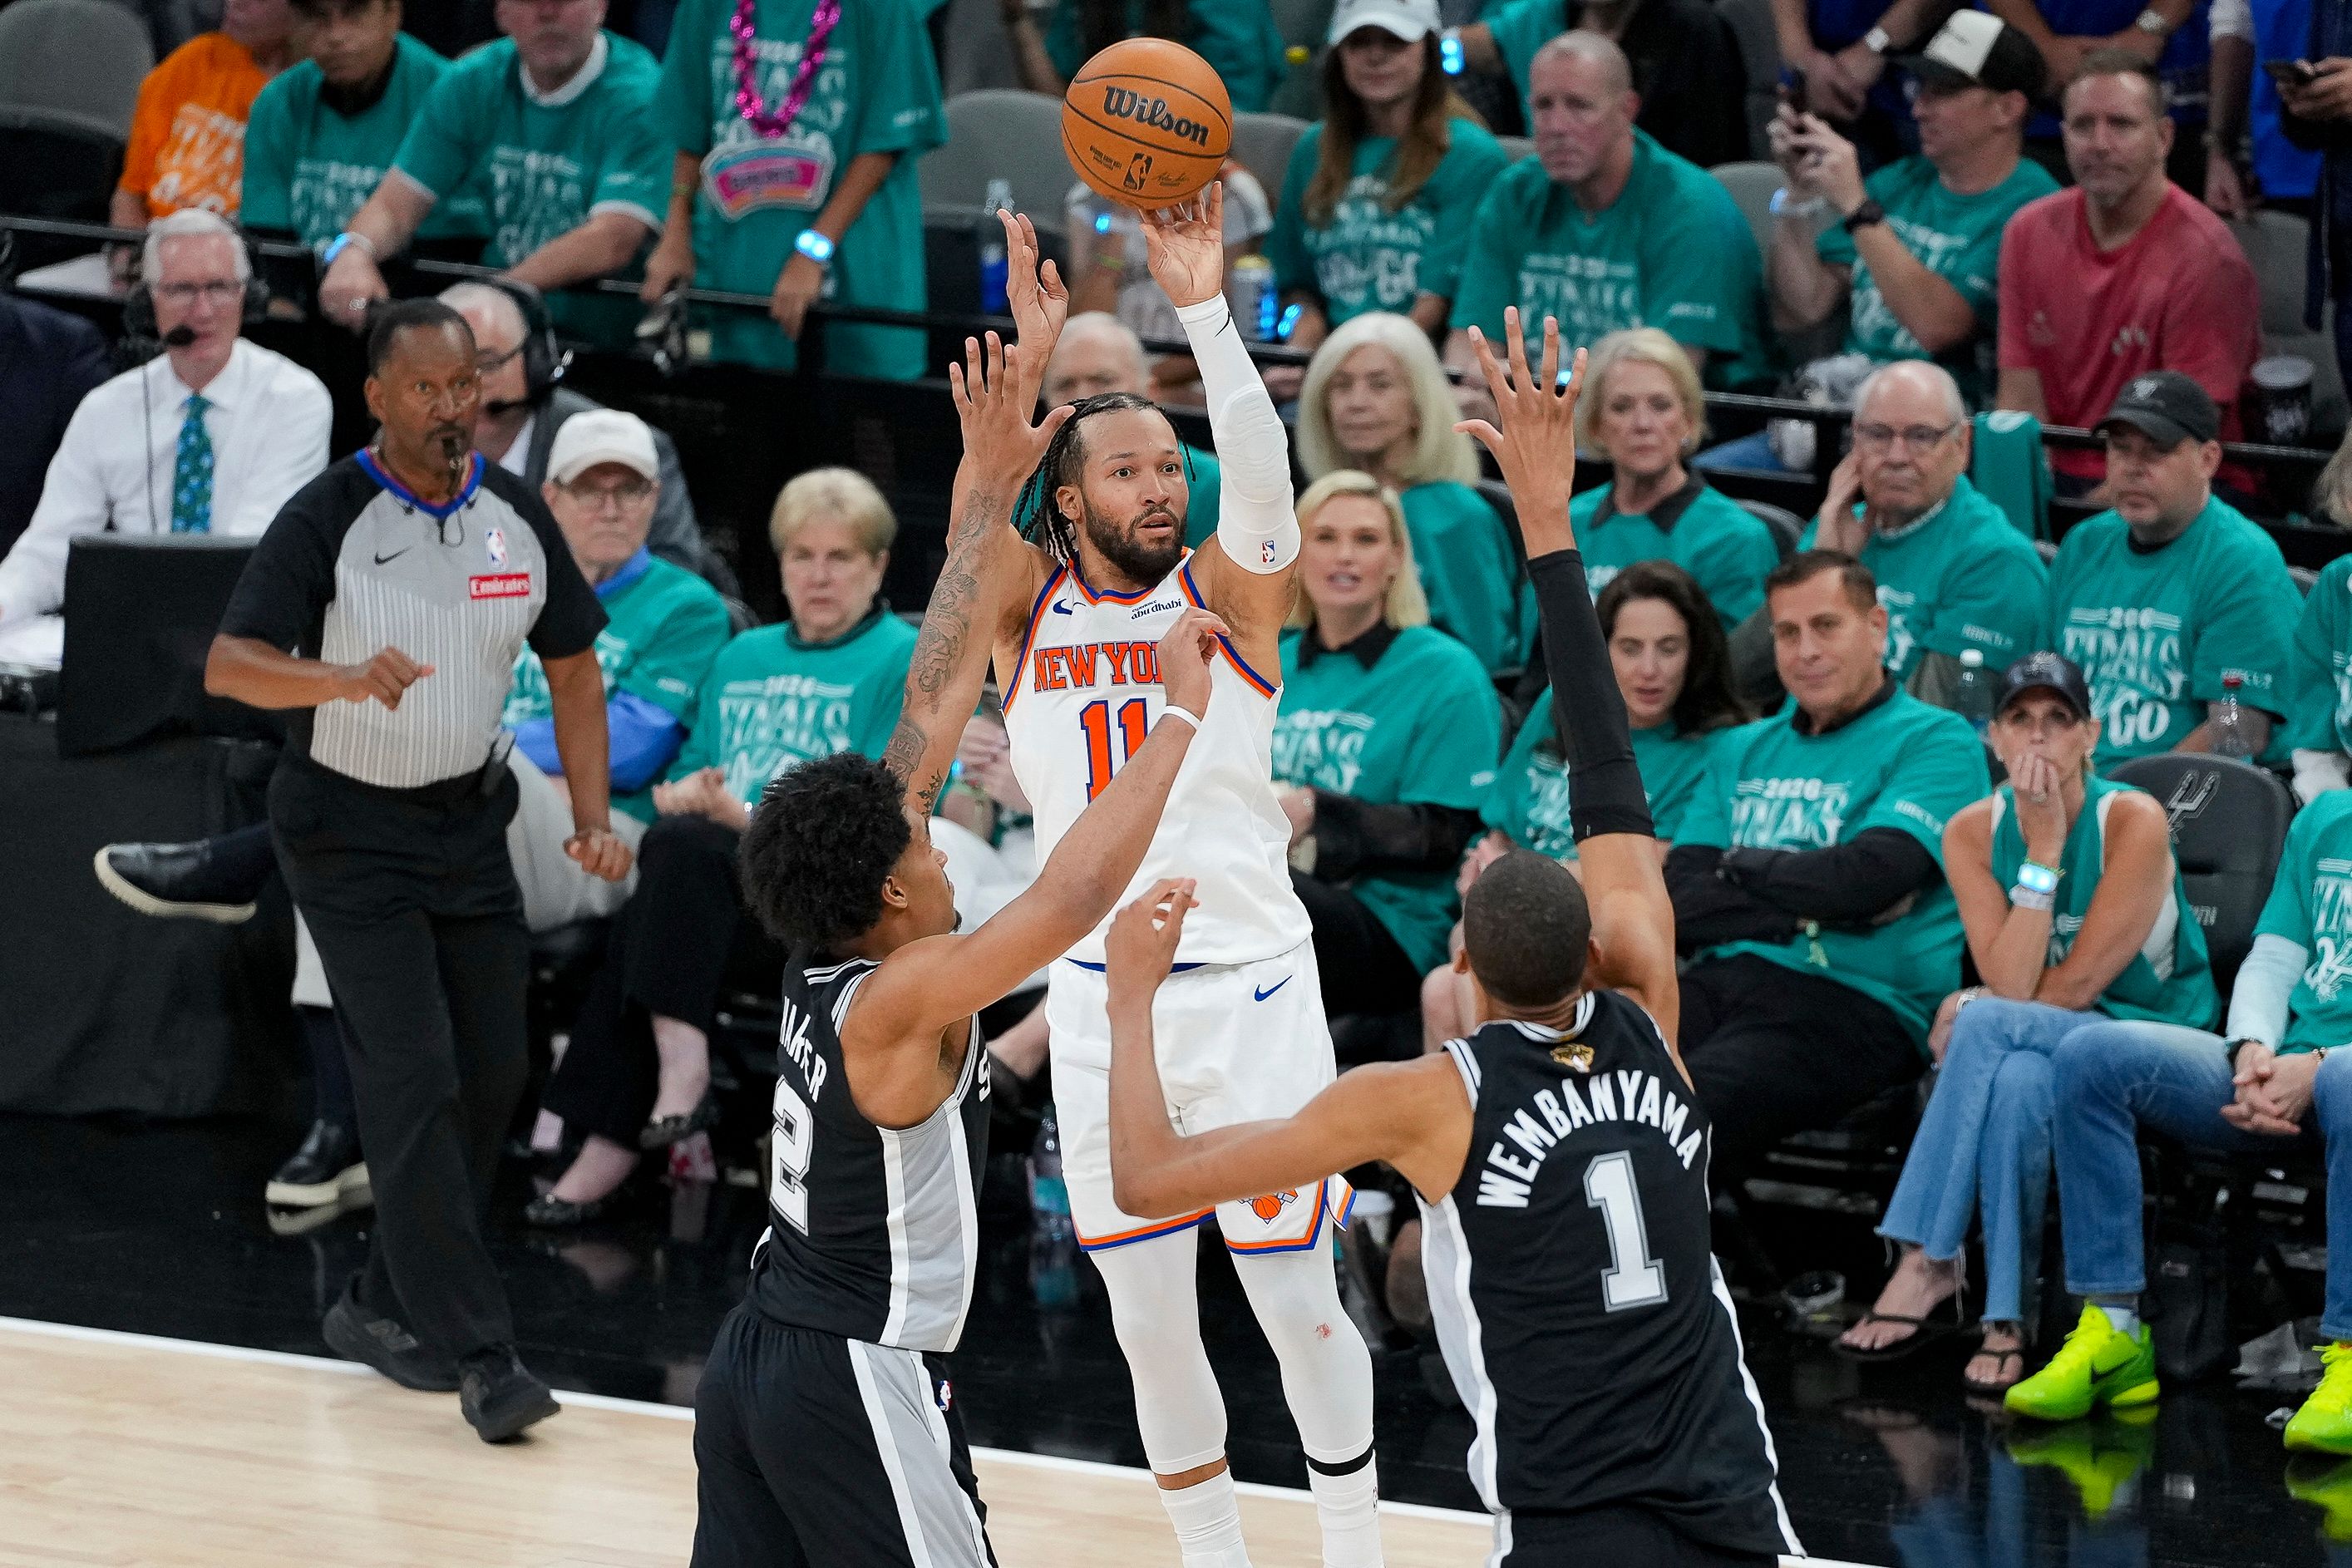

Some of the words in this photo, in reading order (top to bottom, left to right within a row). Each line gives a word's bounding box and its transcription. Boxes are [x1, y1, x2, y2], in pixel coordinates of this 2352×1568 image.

[1103, 85, 1209, 147] Wilson
[1131, 609, 1150, 619] abu
[1151, 599, 1181, 613] dhabi
[1034, 643, 1099, 693] NEW
[1079, 697, 1150, 805] 11
[770, 1073, 814, 1237] 2
[1476, 1069, 1703, 1208] WEMBANYAMA
[1582, 1149, 1669, 1313] 1
